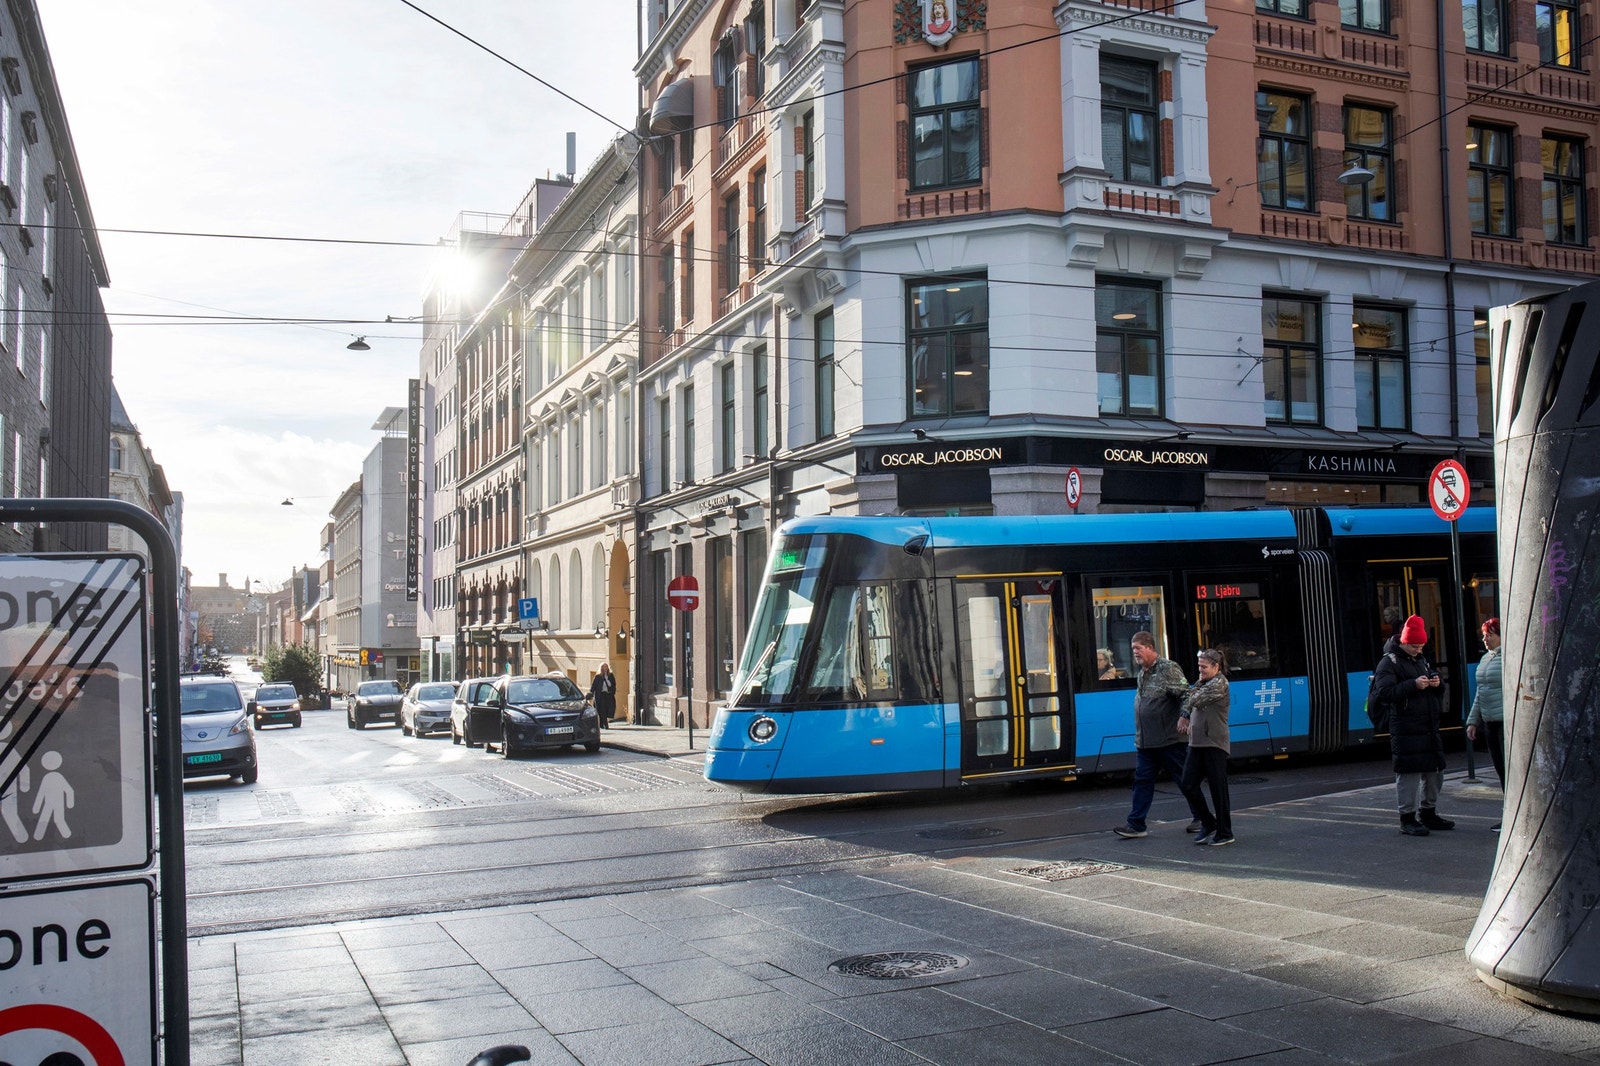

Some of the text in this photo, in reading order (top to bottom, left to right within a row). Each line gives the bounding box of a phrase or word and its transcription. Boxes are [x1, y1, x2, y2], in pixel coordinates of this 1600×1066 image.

[881, 447, 1002, 467] OSCAR JACOBSON
[1104, 448, 1208, 465] OSCAR JACOBSON
[1307, 455, 1397, 473] KASHMINA
[408, 492, 417, 582] MILLENNIUM
[1196, 584, 1241, 599] 13 Ljabru
[523, 601, 533, 617] P
